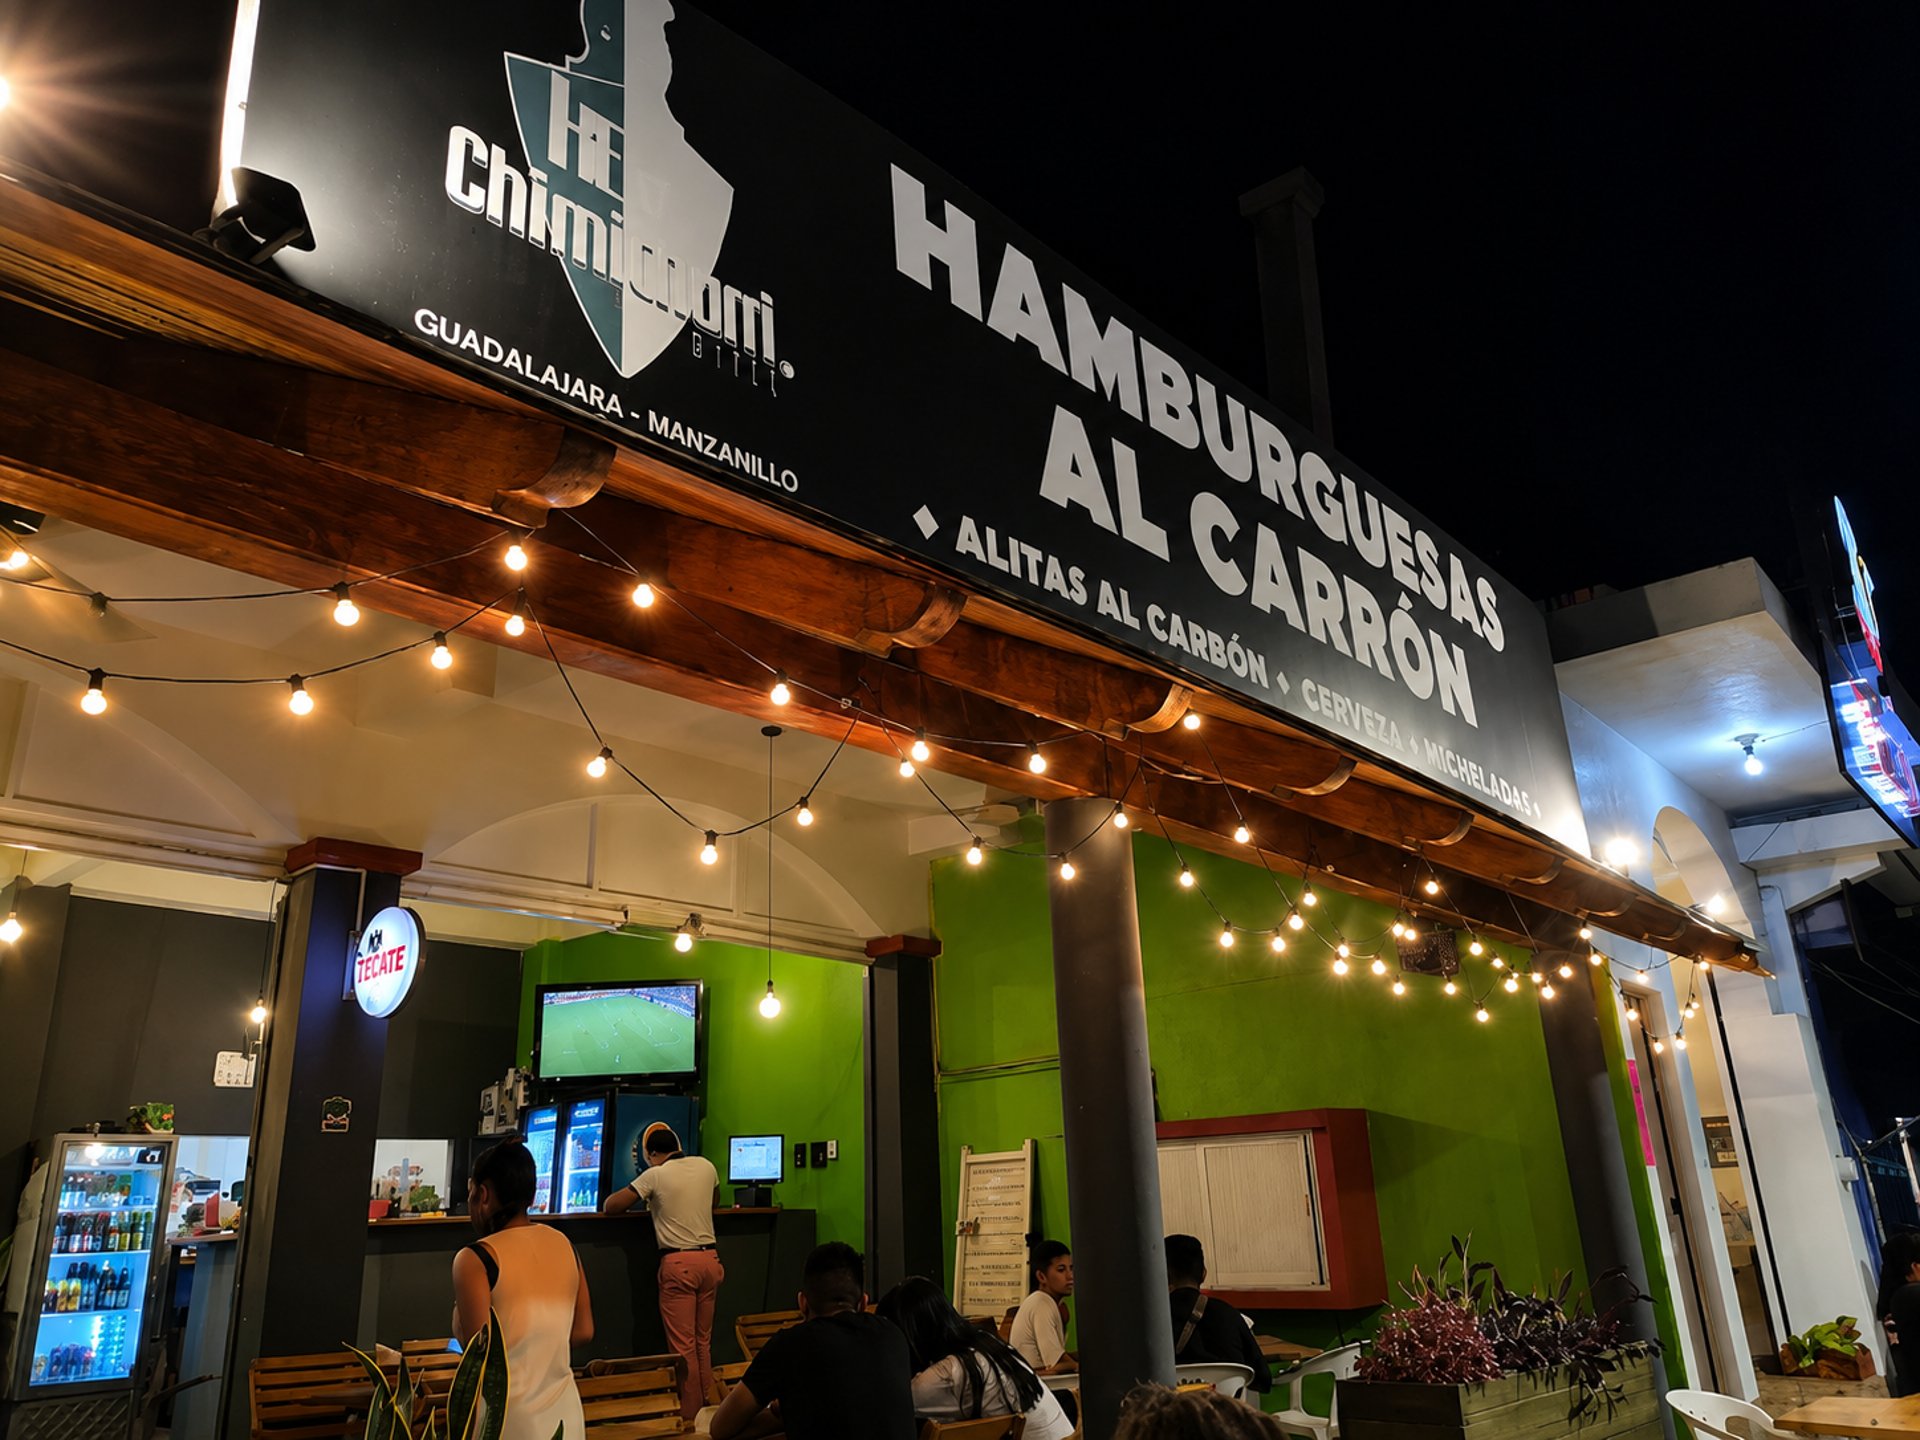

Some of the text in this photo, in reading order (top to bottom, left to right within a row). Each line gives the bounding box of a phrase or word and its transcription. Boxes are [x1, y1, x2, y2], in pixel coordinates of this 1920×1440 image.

[414, 308, 624, 419] GUADALAJARA
[648, 410, 799, 493] MANZANILLO
[891, 162, 1505, 652] HAMBURGUESAS
[1039, 404, 1170, 562] AL
[955, 515, 1532, 817] ALITAS AL CARBÓN CERVEZA MICHELADAS
[358, 945, 406, 983] TECATE
